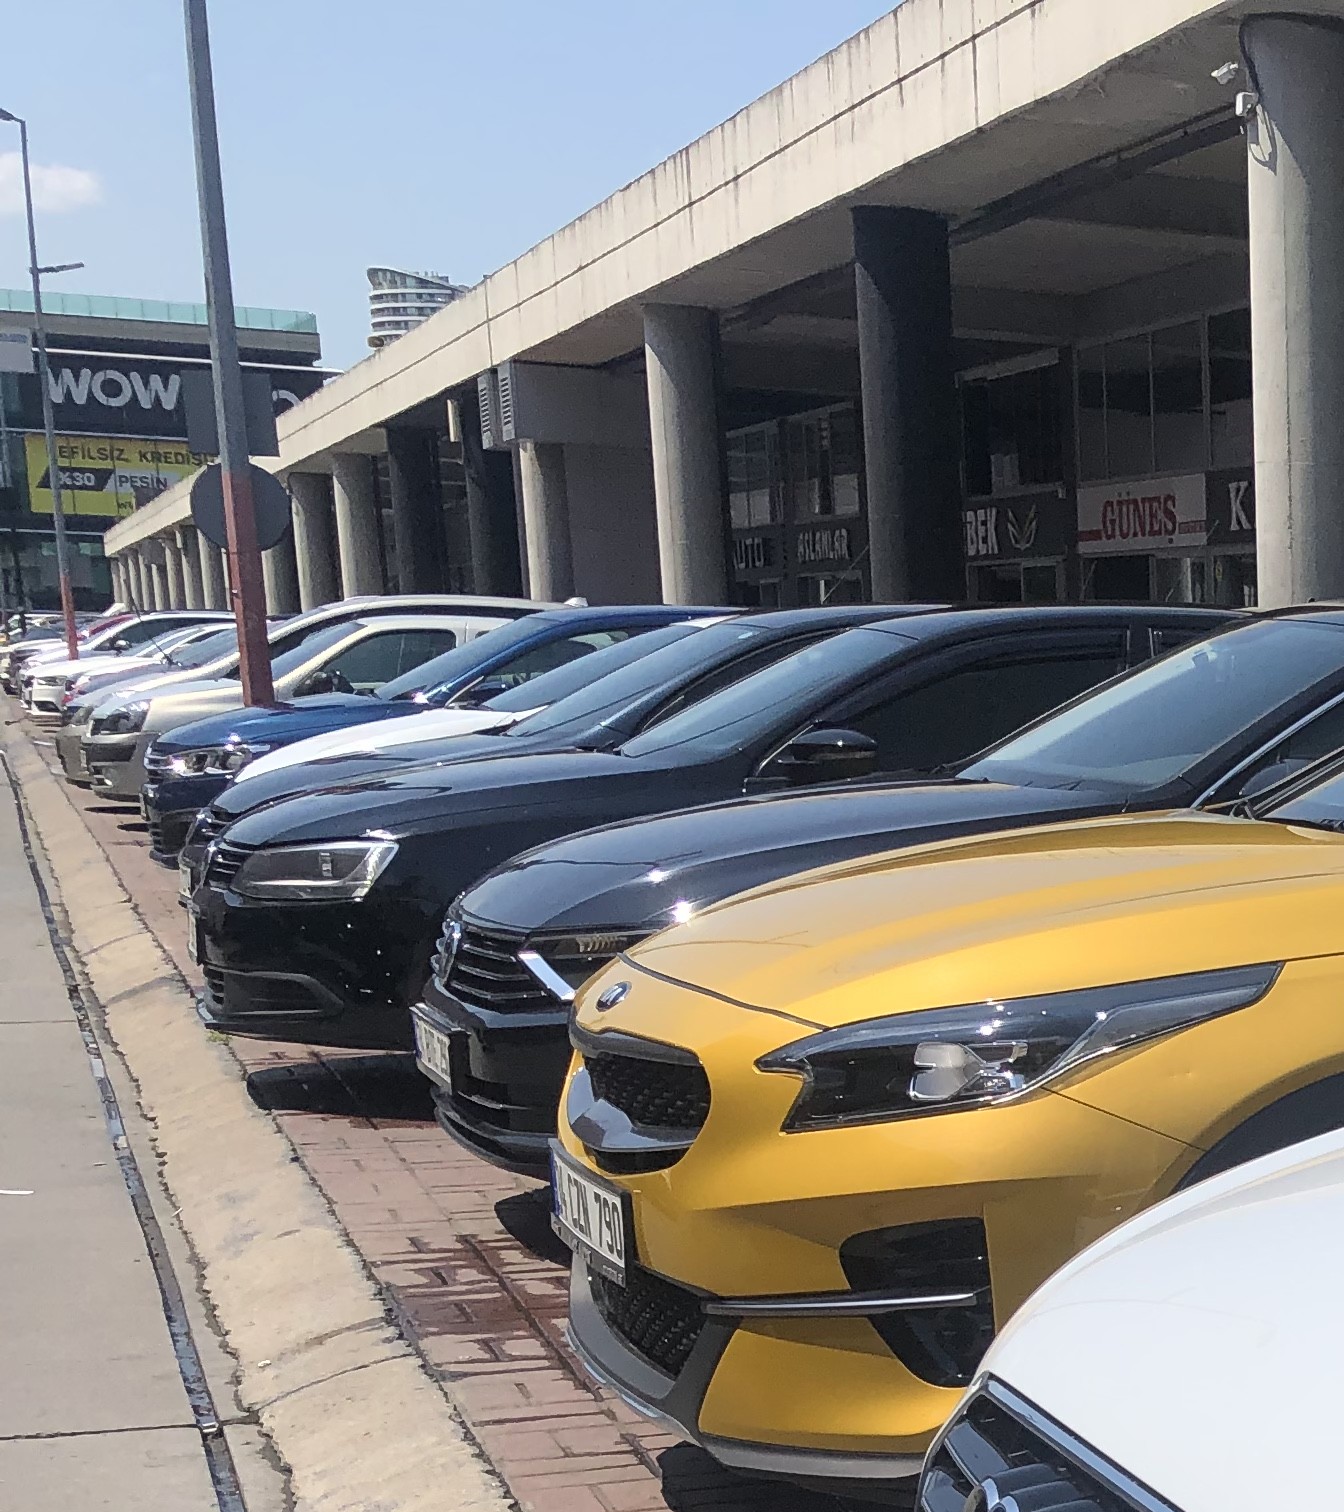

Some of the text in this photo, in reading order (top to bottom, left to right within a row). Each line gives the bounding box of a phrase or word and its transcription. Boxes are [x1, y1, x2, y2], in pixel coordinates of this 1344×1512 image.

[46, 367, 182, 411] WOW
[58, 444, 130, 463] EFİLSİZ
[962, 506, 999, 557] BEK
[1101, 490, 1178, 545] GÜNEŞ
